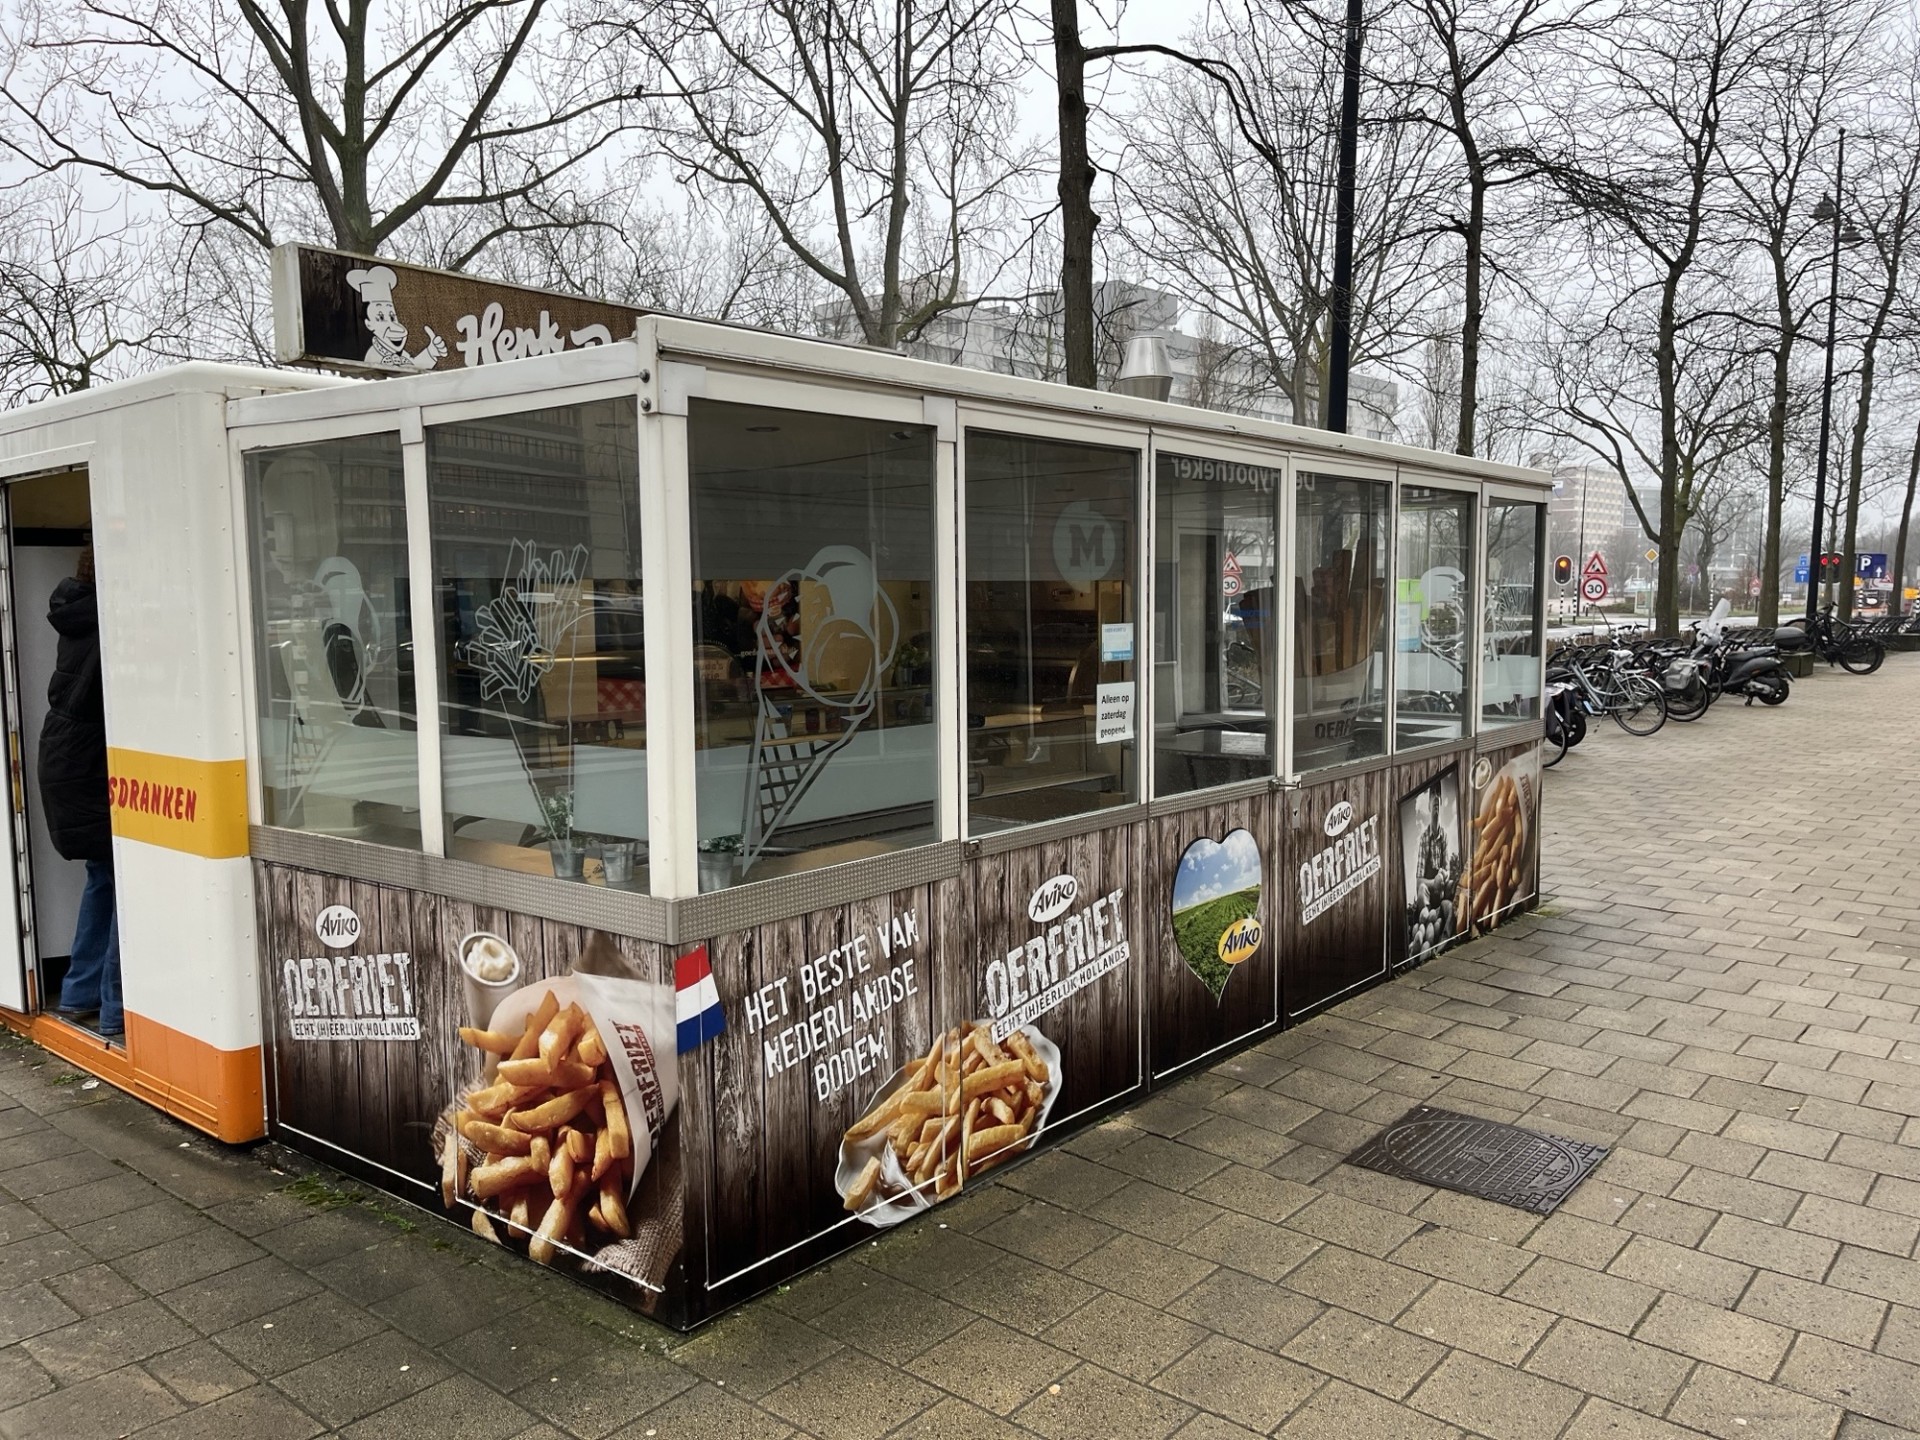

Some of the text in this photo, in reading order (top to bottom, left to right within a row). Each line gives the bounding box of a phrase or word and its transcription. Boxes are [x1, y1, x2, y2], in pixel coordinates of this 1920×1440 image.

[456, 302, 565, 368] Henk
[1861, 558, 1871, 571] P
[1224, 581, 1237, 590] 30
[1587, 584, 1603, 594] 30
[1101, 709, 1127, 720] zaterdag
[1102, 694, 1130, 704] Alleen op
[1101, 725, 1126, 738] geopend
[1299, 813, 1379, 906] OERFRIET
[1032, 880, 1075, 918] Aviko
[319, 912, 359, 937] Aviko
[1221, 924, 1260, 957] Aviko
[985, 887, 1126, 1019] OERFRIET
[283, 952, 414, 1016] OERFRIET
[744, 908, 920, 1035] HET BESTE VAN
[996, 1013, 1022, 1039] ECHT
[1080, 946, 1126, 985] HOLLANDS
[295, 1023, 315, 1036] ECHT
[366, 1021, 416, 1036] HOLLANDS
[763, 958, 918, 1078] NEDERLANDSE
[813, 1025, 889, 1101] BODEM
